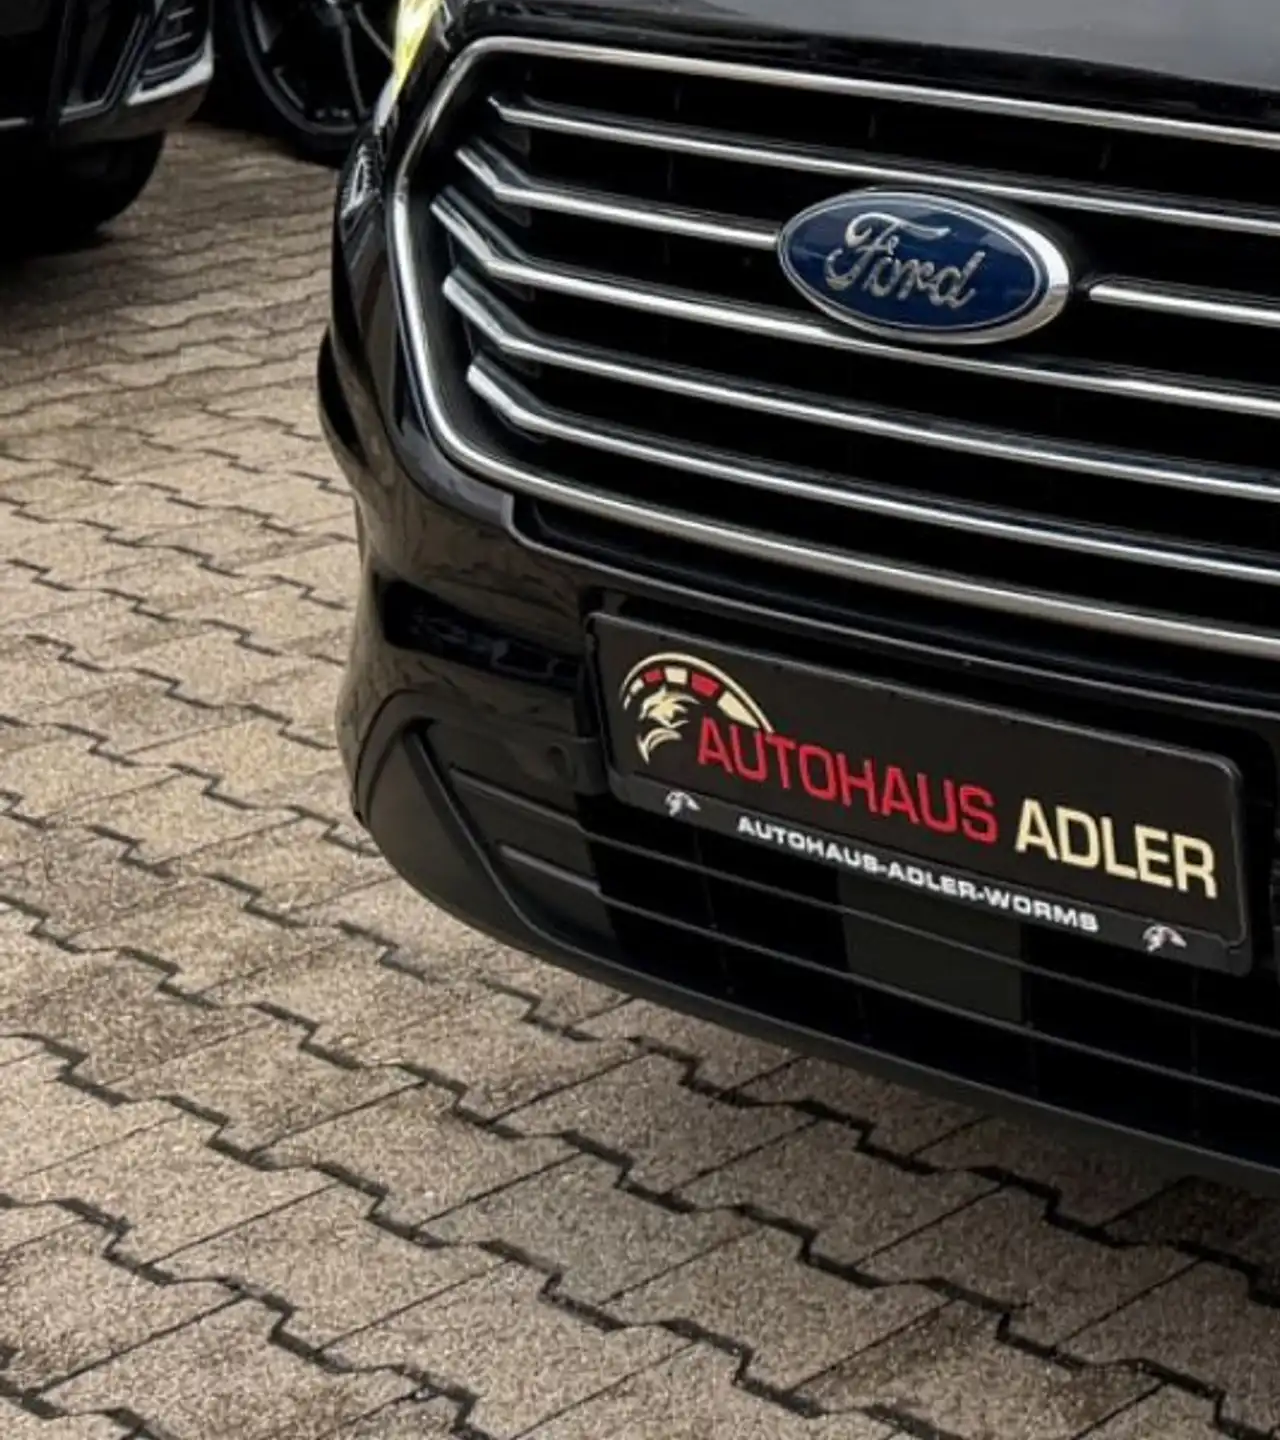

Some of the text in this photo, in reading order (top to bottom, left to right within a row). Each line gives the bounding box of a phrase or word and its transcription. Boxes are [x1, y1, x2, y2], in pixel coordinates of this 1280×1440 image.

[823, 212, 986, 308] Ford
[699, 717, 1219, 898] AUTOHAUS ADLER
[737, 814, 1099, 934] AUTOHAUS-ADLER-WORMS
